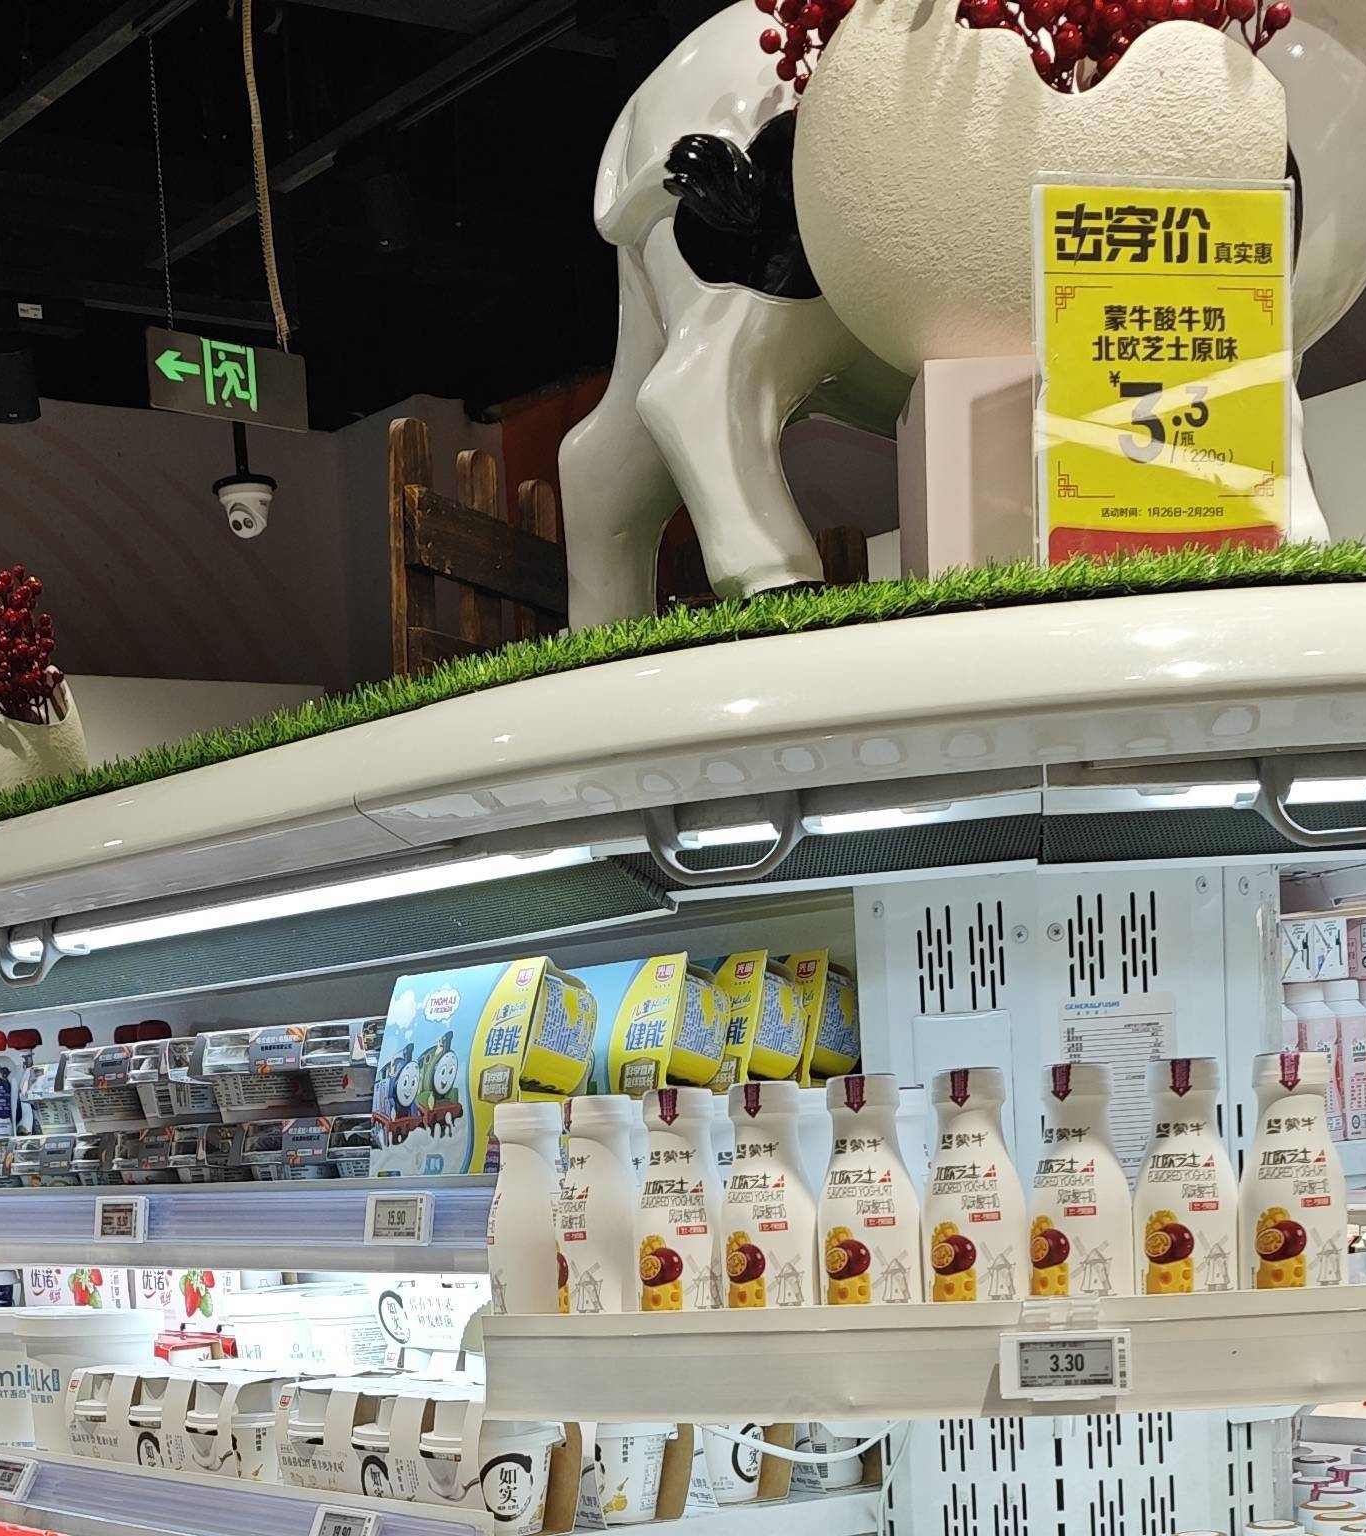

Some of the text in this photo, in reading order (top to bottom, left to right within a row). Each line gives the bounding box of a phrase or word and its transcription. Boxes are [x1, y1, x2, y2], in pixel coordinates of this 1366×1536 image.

[1055, 203, 1273, 266] 击穿价 真实惠
[1104, 305, 1226, 332] 蒙牛酸牛奶
[1092, 336, 1239, 362] 北欧芝士原味
[430, 995, 457, 1007] THOMAS
[484, 1025, 520, 1057] 健能
[626, 1020, 665, 1052] 健能
[387, 1210, 406, 1225] 15.90
[1050, 1354, 1084, 1372] 3.30
[497, 1466, 519, 1503] 如实
